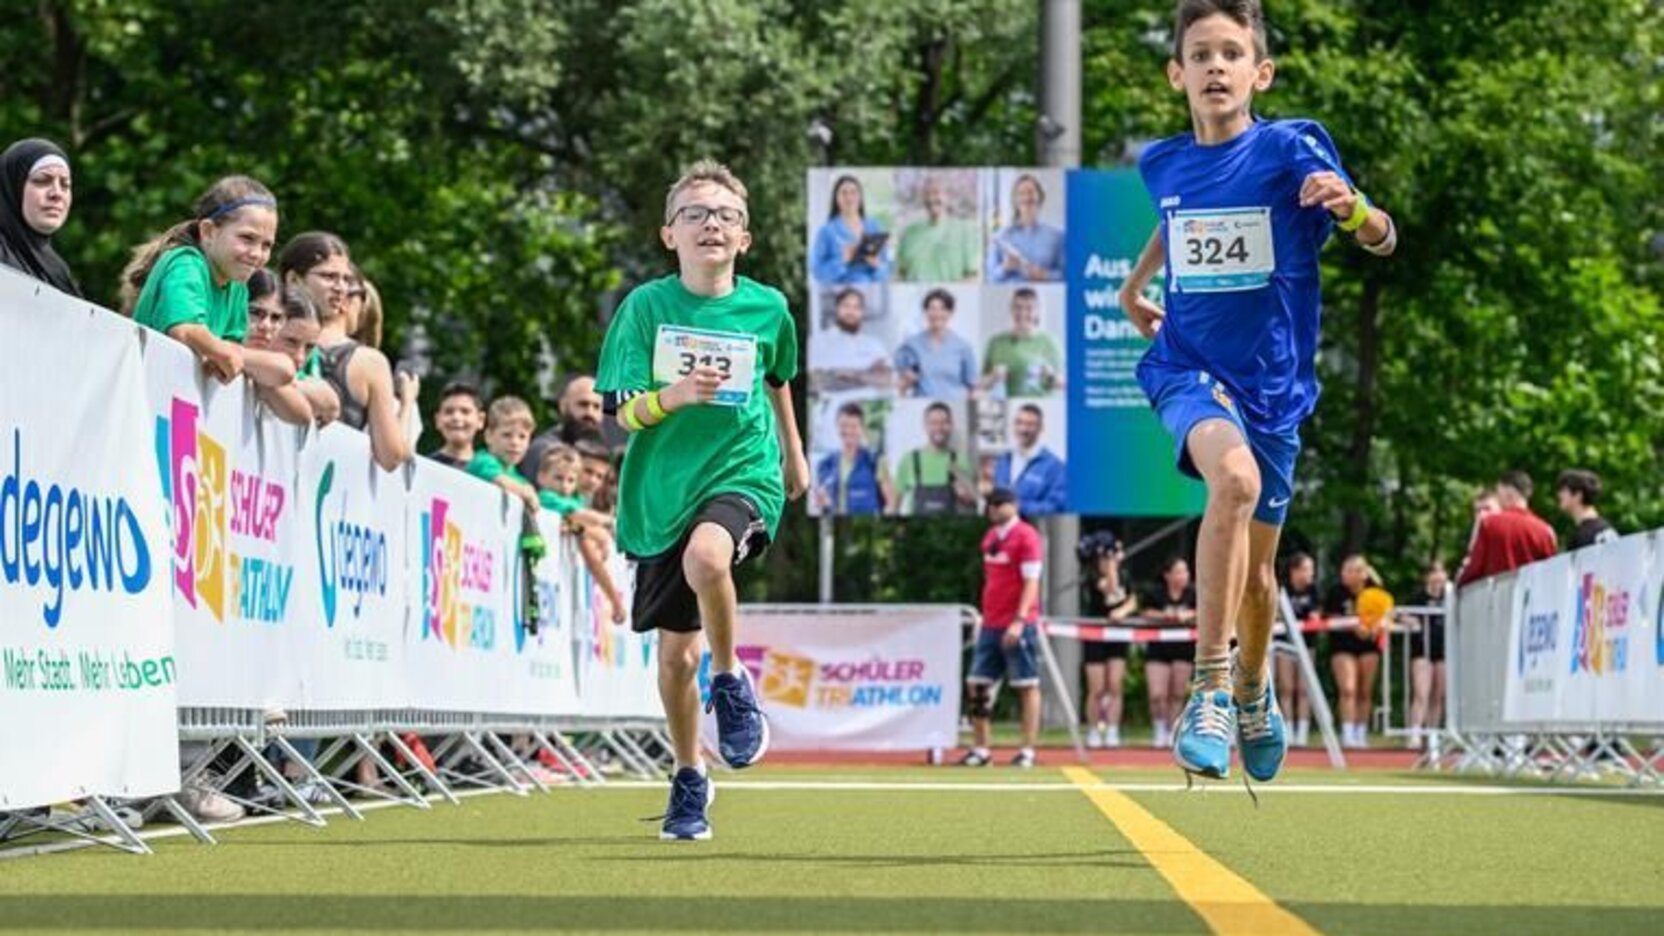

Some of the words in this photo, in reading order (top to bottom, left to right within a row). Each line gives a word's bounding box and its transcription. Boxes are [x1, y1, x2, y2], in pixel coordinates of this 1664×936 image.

[1186, 236, 1249, 265] 324
[1084, 253, 1131, 280] Aus
[1084, 315, 1141, 340] Dan
[0, 427, 152, 628] degewo
[4, 648, 35, 690] Mehr
[821, 654, 925, 682] SCHÜLER
[817, 684, 941, 708] TRIATHLON
